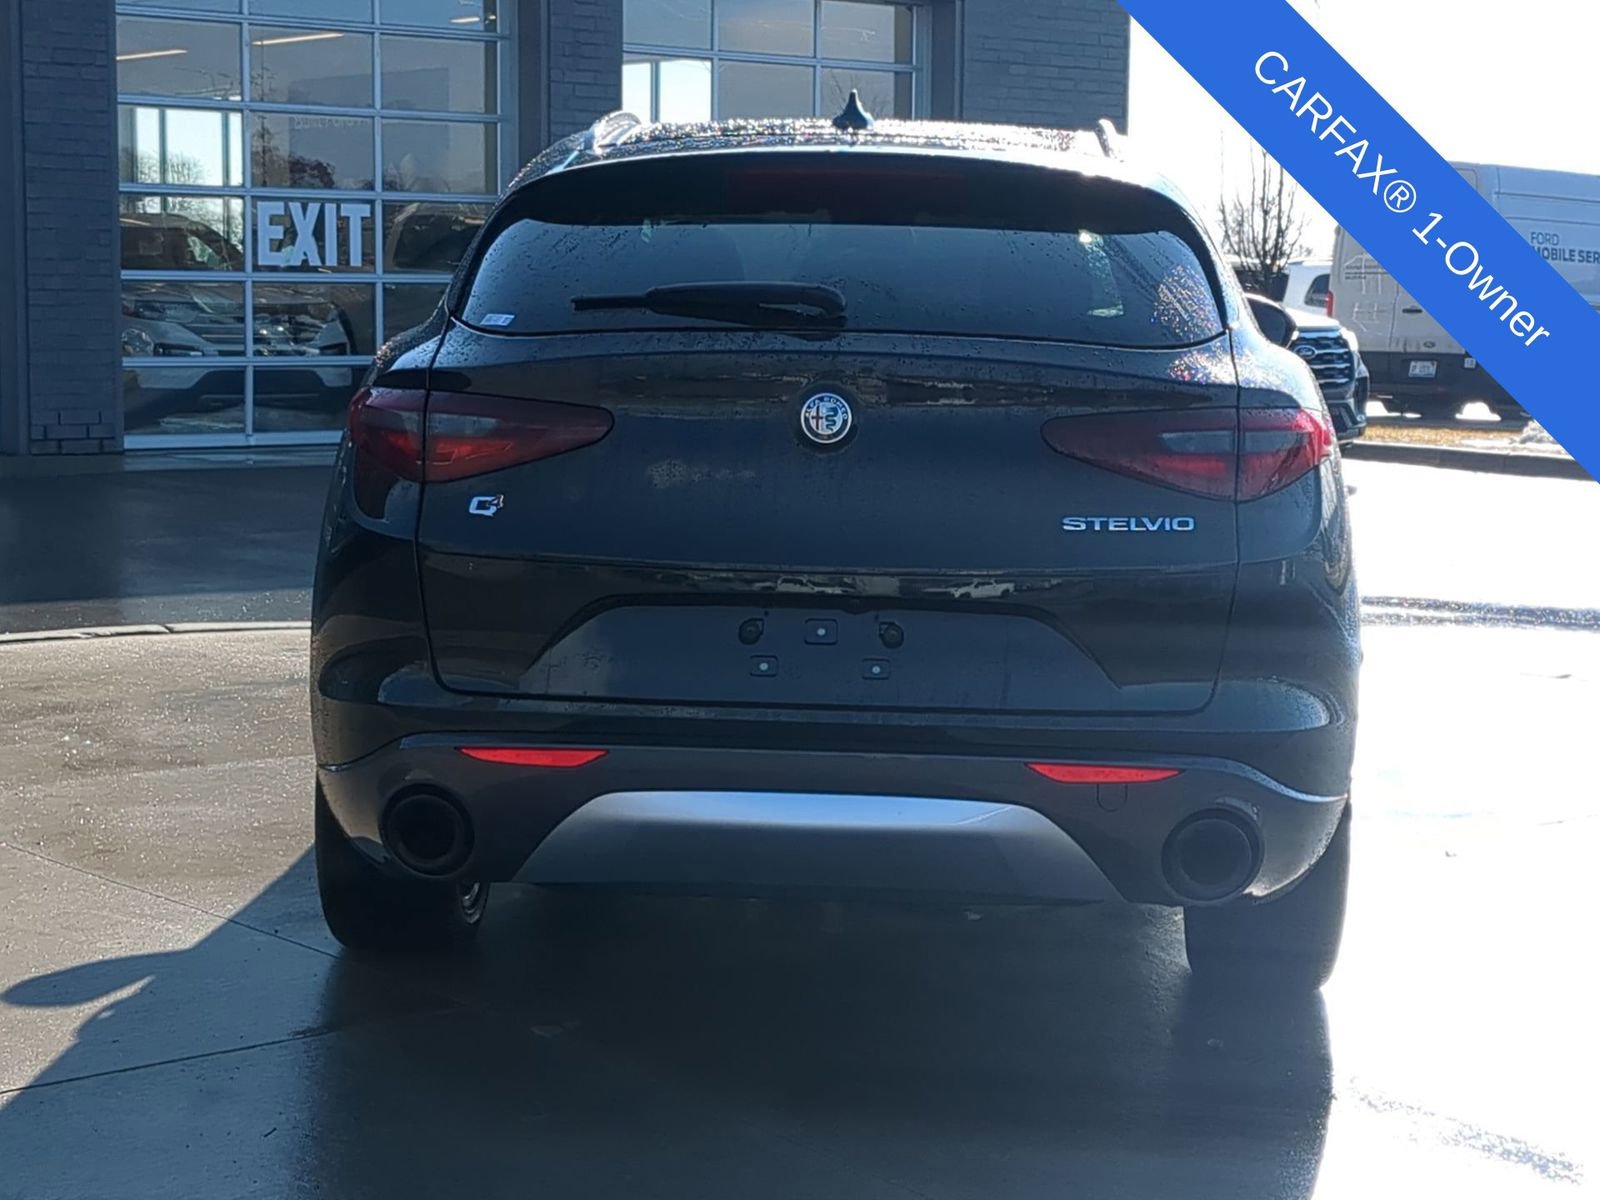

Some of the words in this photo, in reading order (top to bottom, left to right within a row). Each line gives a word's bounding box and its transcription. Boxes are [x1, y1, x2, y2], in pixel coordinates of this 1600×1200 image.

[257, 201, 371, 267] EXIT
[1531, 232, 1560, 245] FORD
[1063, 517, 1195, 531] STELVIO
